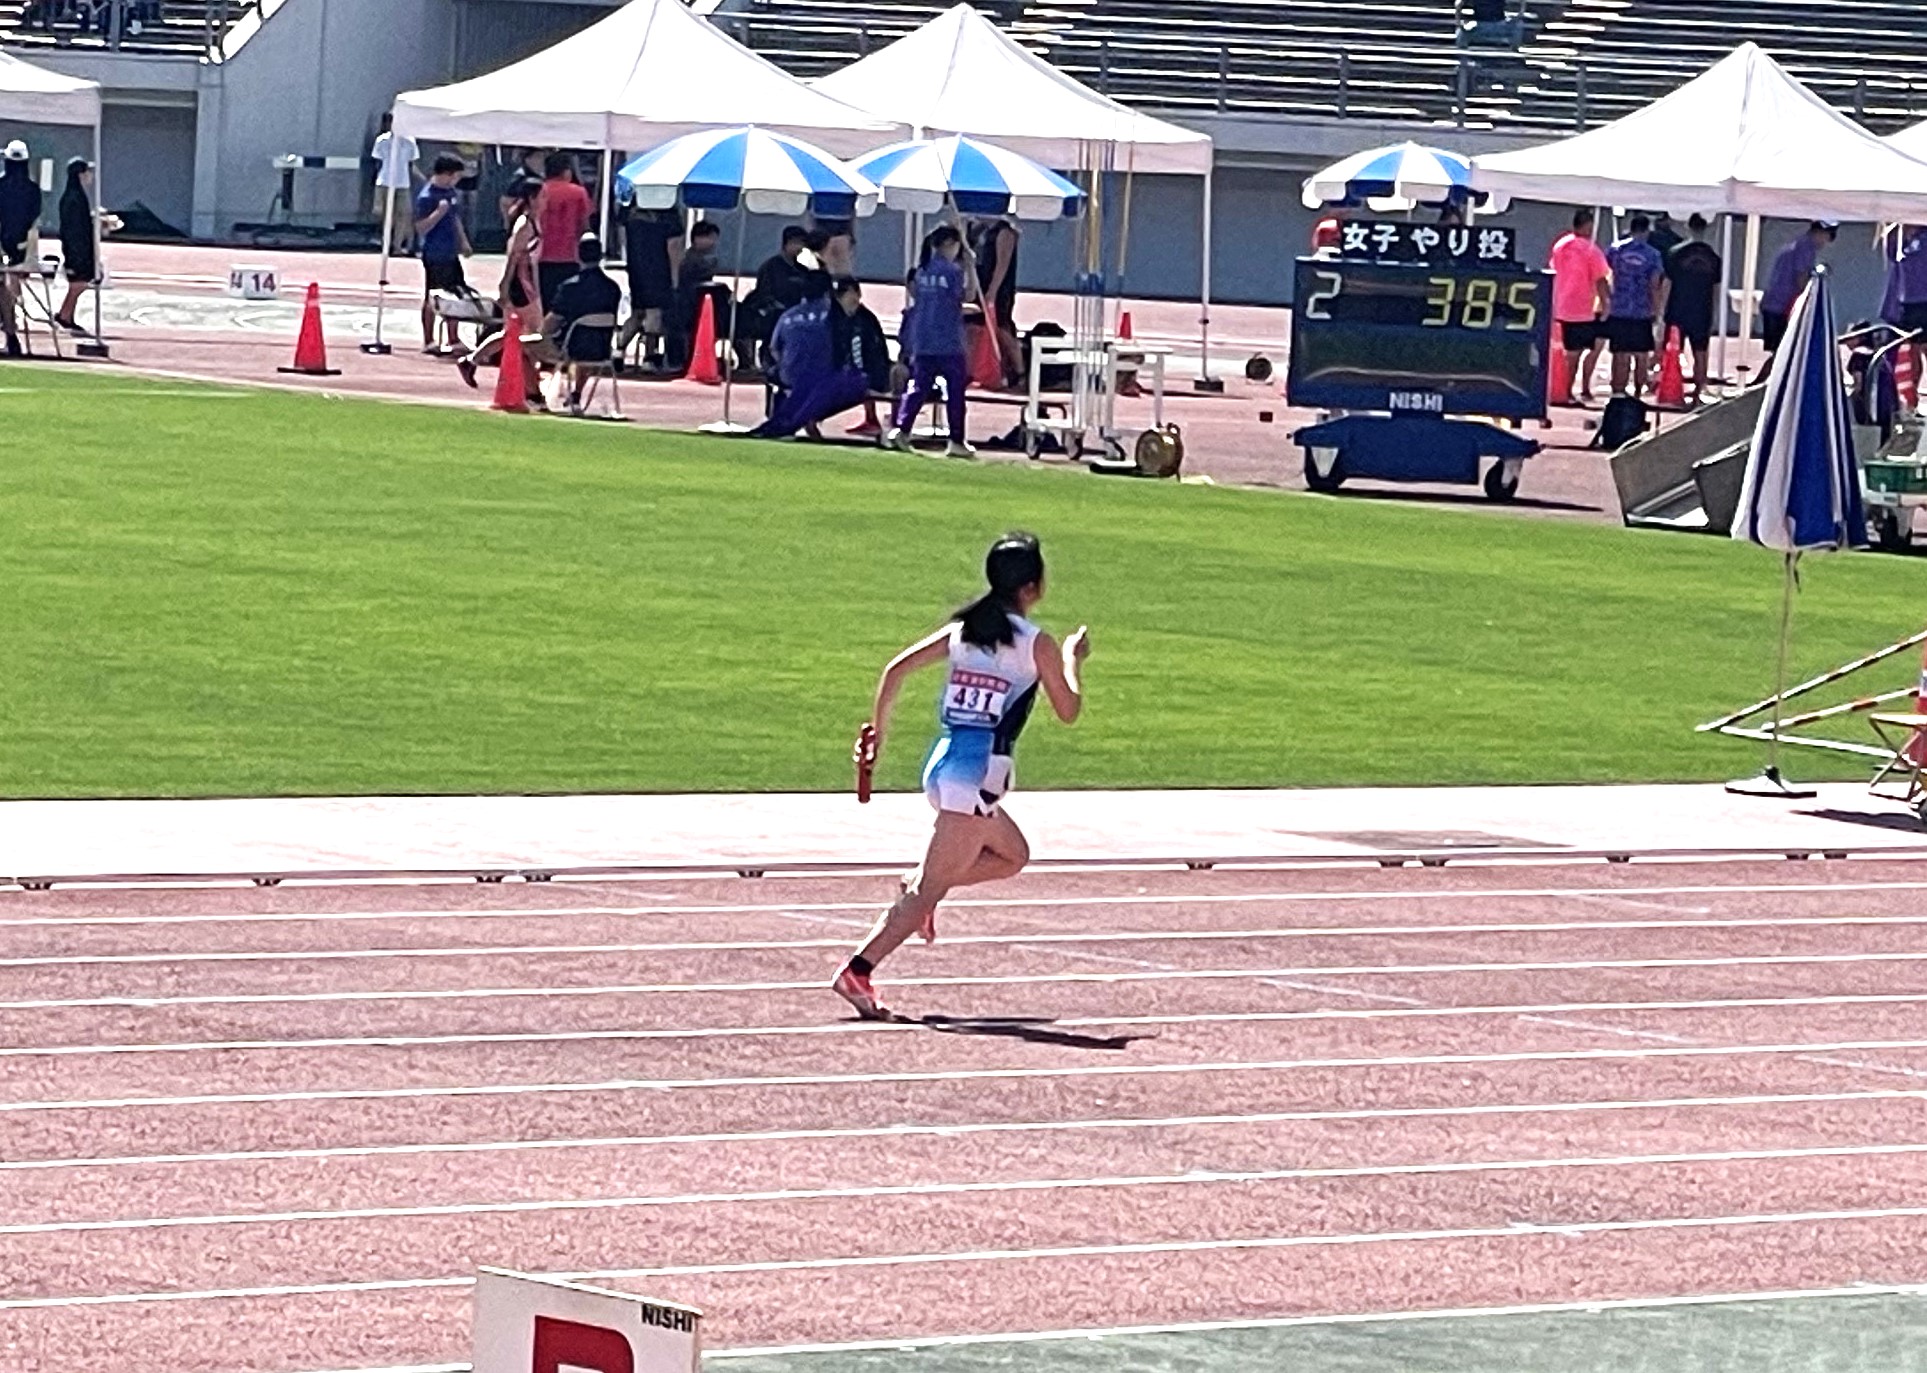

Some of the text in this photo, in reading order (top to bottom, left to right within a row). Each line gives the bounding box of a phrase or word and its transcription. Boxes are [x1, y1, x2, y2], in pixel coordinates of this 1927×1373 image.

[251, 273, 276, 292] 14
[1306, 271, 1539, 331] 2 385
[1389, 391, 1443, 412] NISHI
[953, 687, 993, 711] 431
[641, 1303, 692, 1333] NISHI
